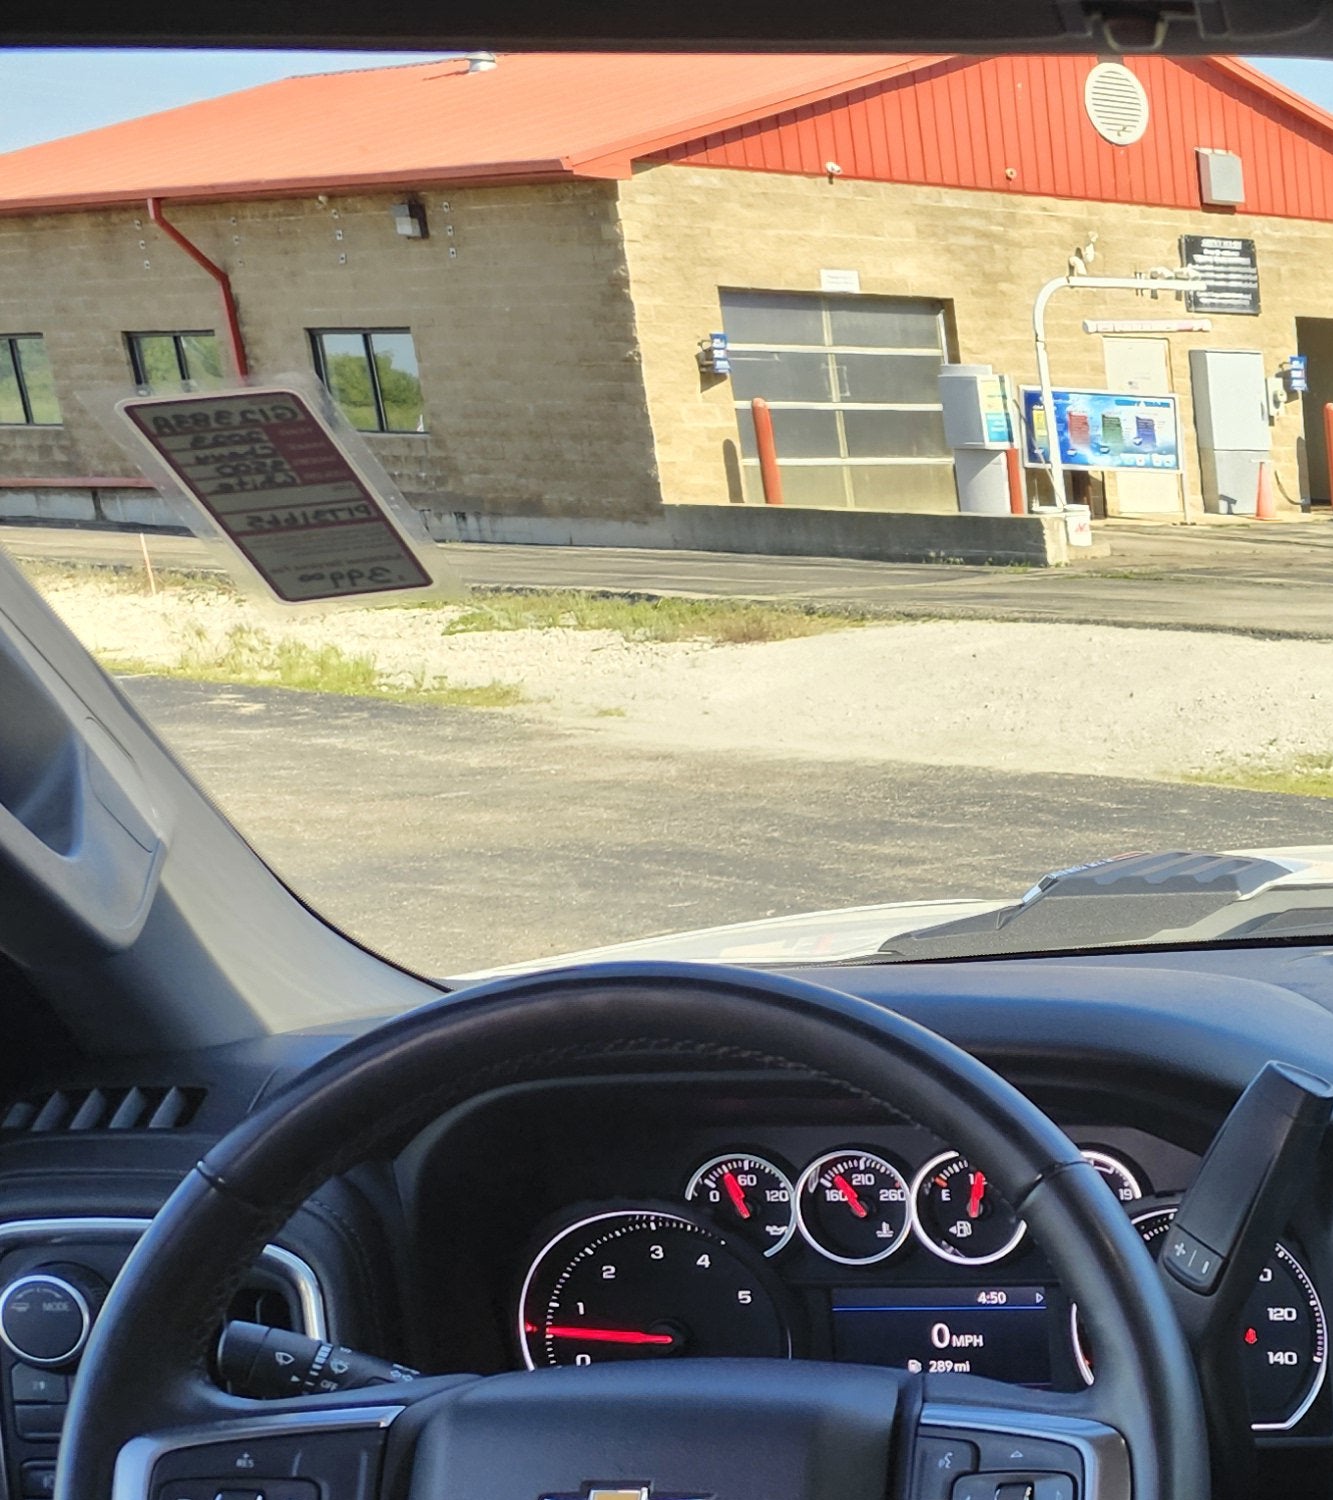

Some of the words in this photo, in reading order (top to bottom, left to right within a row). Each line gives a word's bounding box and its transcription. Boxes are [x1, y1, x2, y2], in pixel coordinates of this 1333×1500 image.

[737, 1174, 757, 1186] 60
[851, 1174, 874, 1186] 210
[709, 1191, 720, 1202] 0
[765, 1190, 789, 1201] 120
[879, 1189, 906, 1201] 260
[941, 1189, 951, 1201] E
[1118, 1188, 1133, 1200] 19
[650, 1245, 664, 1259] 3
[696, 1254, 711, 1268] 4
[602, 1265, 616, 1279] 2
[738, 1290, 752, 1304] 5
[977, 1292, 1007, 1304] 4:50
[42, 1301, 70, 1313] MODE
[577, 1302, 585, 1315] 1
[1267, 1307, 1297, 1321] 120
[931, 1323, 950, 1348] 0
[952, 1335, 984, 1348] MPH
[1267, 1351, 1297, 1365] 140
[928, 1360, 953, 1373] 289
[954, 1360, 970, 1372] mi
